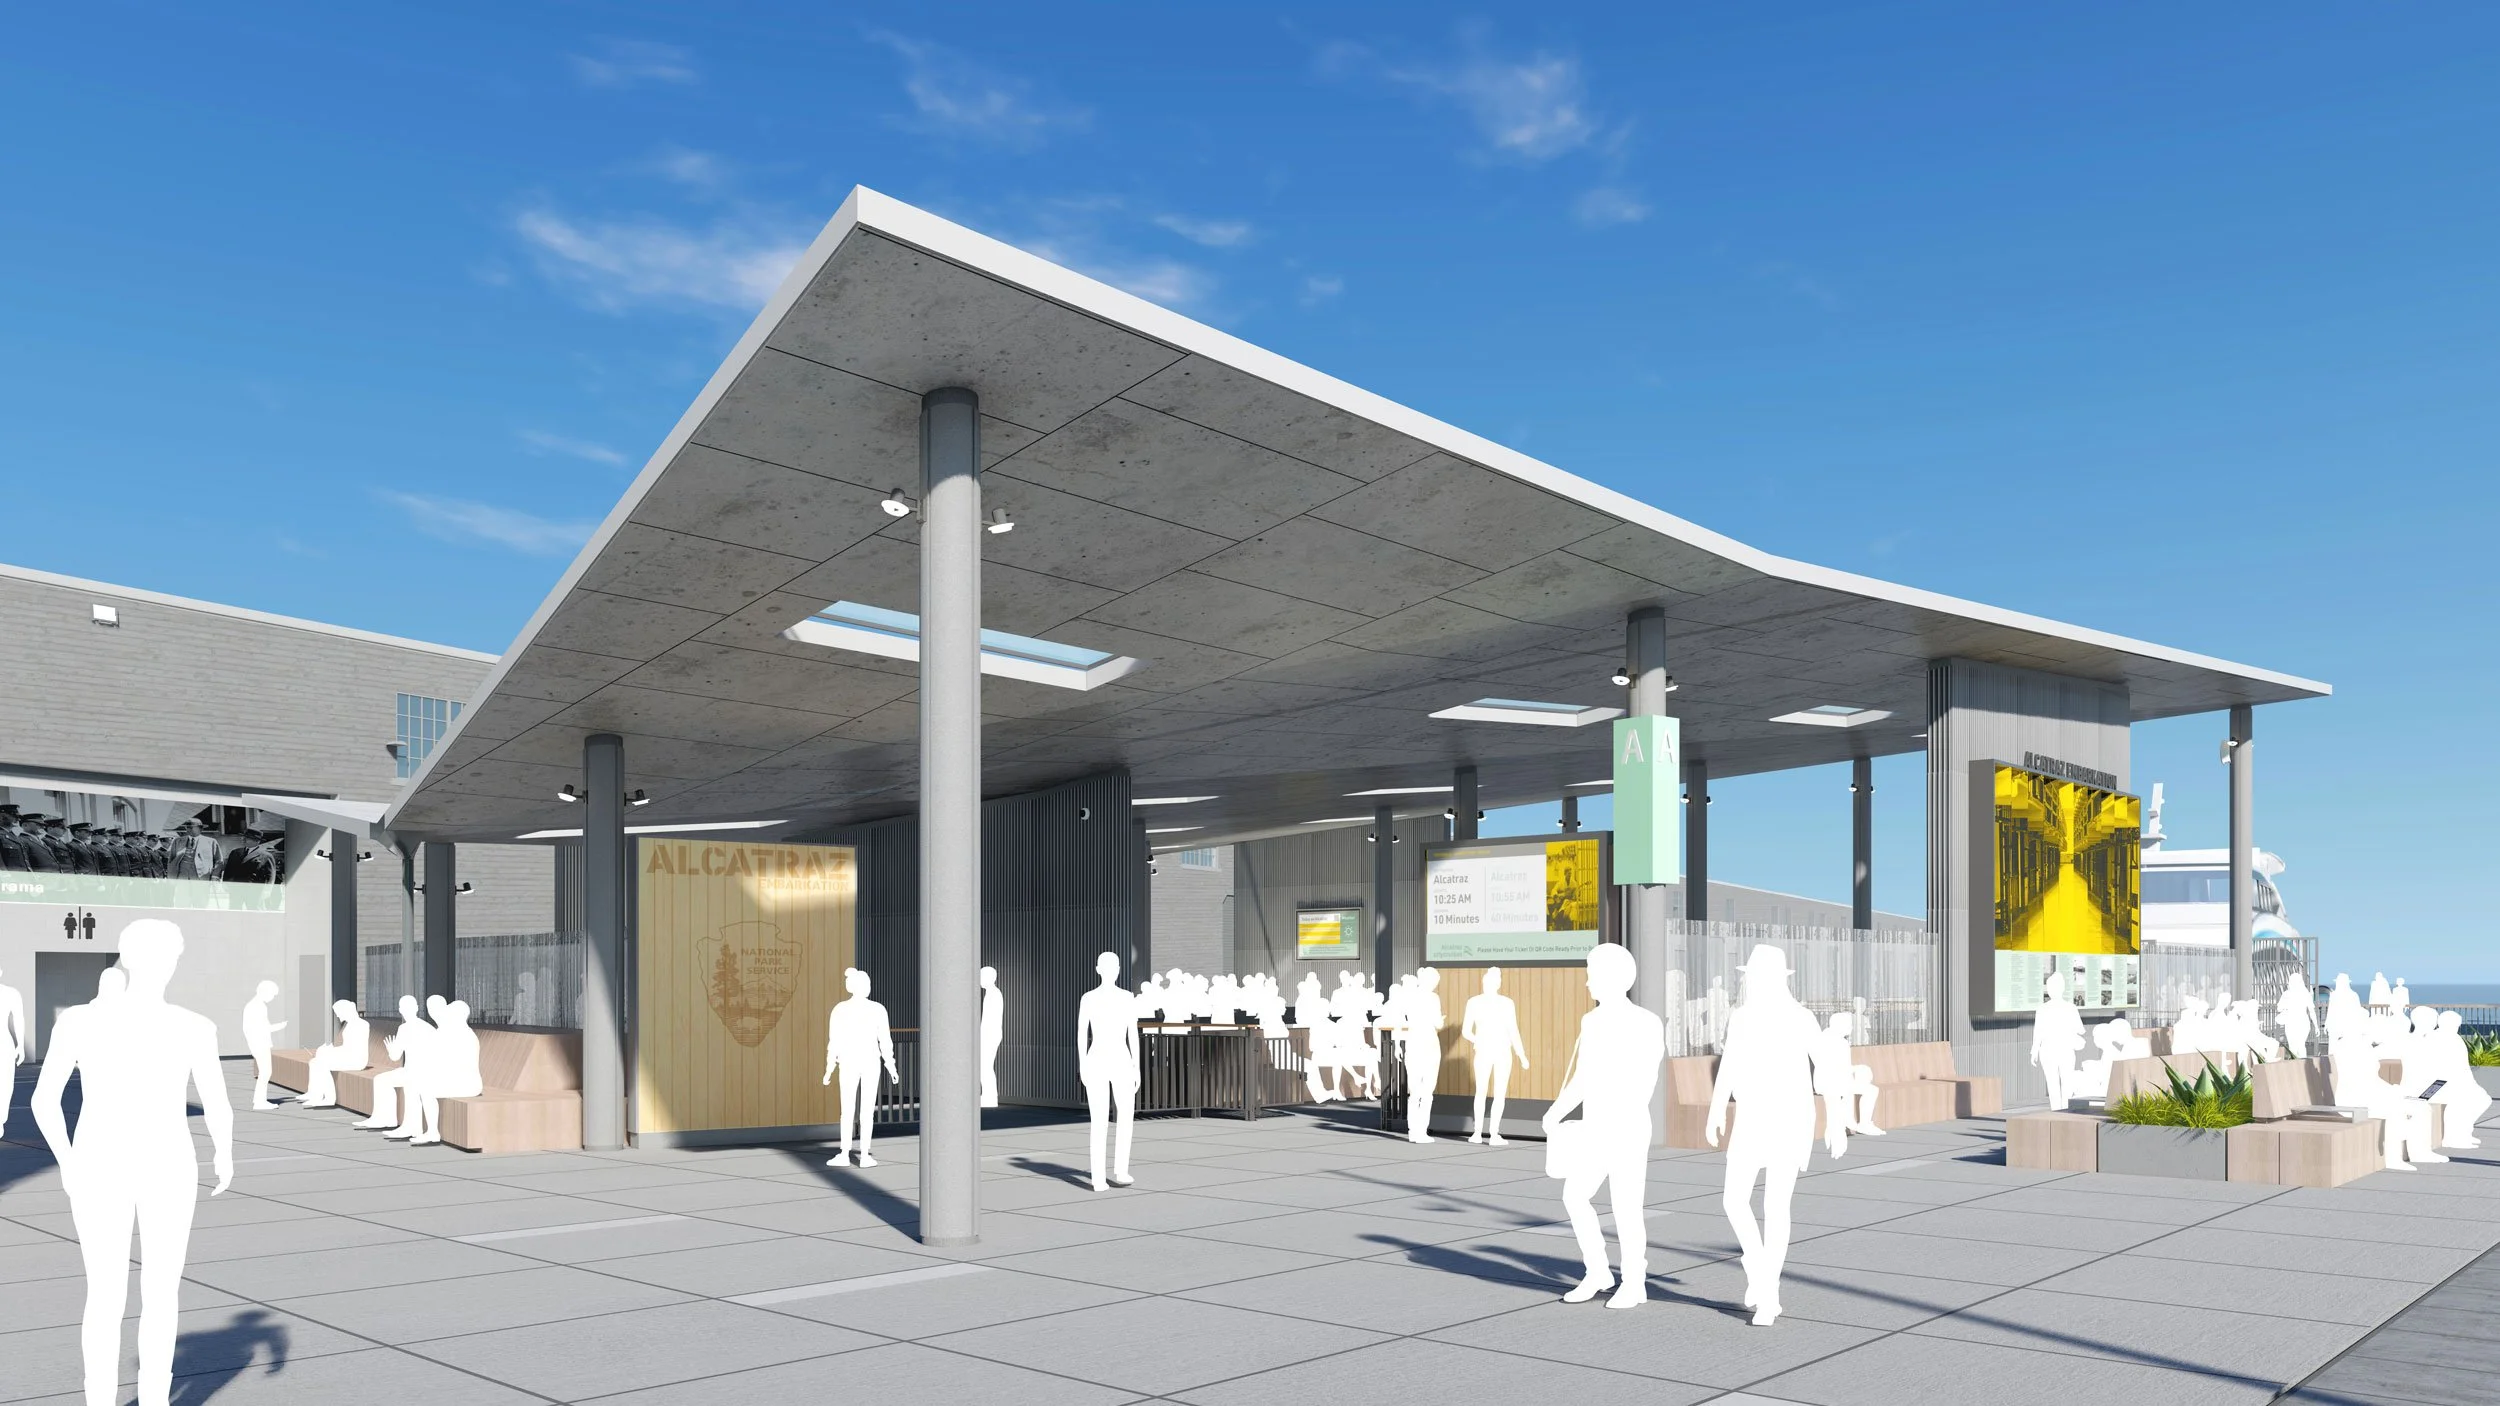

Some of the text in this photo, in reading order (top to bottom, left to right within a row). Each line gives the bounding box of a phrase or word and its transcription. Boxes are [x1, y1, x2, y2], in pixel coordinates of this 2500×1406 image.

[1621, 728, 1645, 765] A
[1656, 728, 1678, 764] A
[2024, 750, 2066, 777] ALCATRAZ
[646, 844, 850, 879] ALCATRAZ
[1434, 874, 1469, 884] Alcatraz
[1491, 871, 1528, 882] Alcatraz
[759, 878, 849, 892] EMBARKATION
[1434, 893, 1472, 905] 10:25 AM
[1516, 890, 1531, 903] AM
[1434, 914, 1480, 924] 10 Minutes
[1502, 912, 1539, 923] Minutes
[741, 948, 794, 957] NATIONAL
[754, 957, 782, 965] PARK
[746, 966, 790, 975] SERVICE
